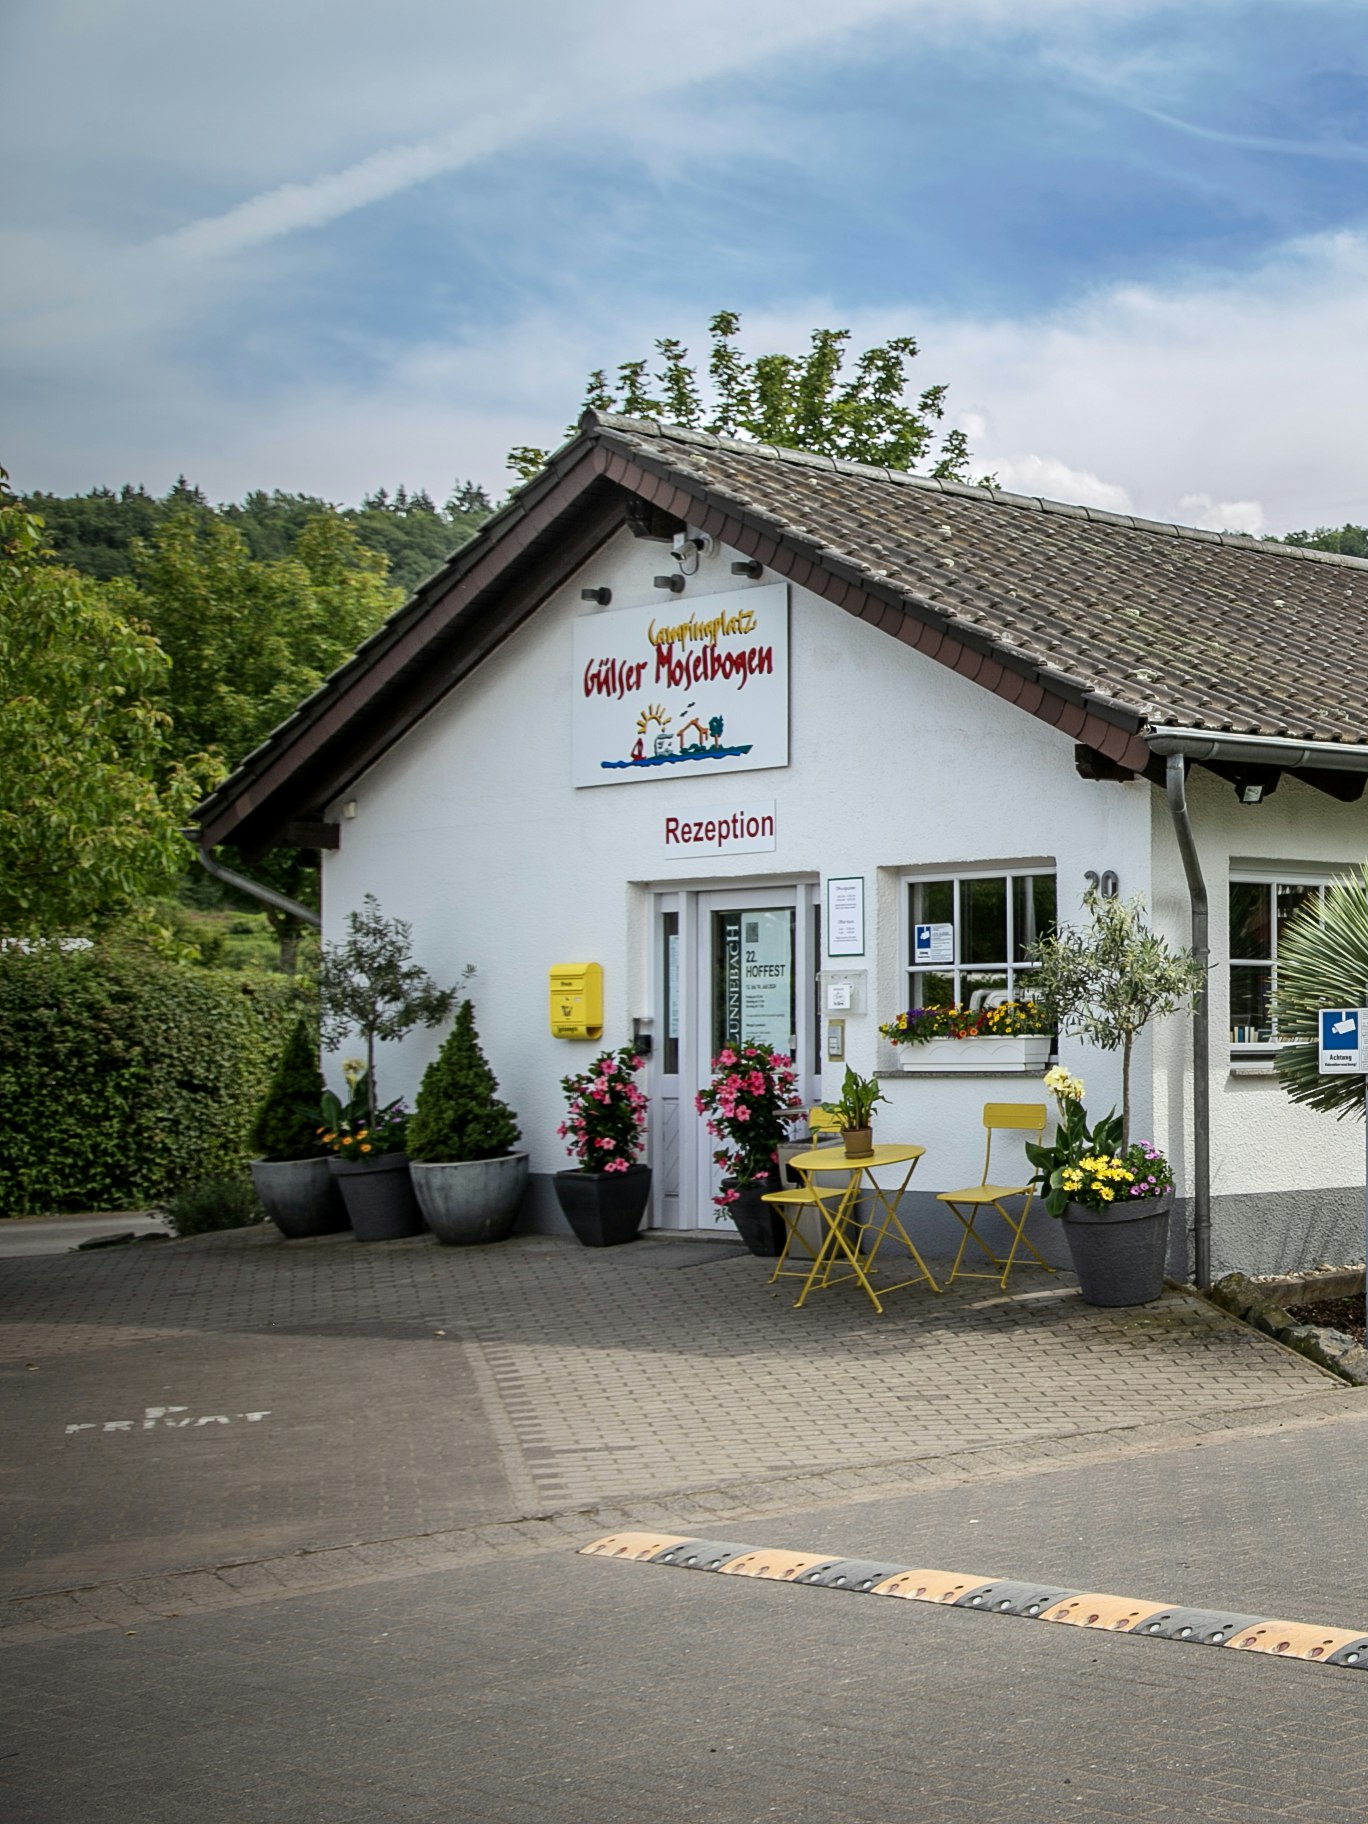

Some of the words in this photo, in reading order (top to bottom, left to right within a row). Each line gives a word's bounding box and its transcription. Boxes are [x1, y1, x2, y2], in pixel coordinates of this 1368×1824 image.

[647, 609, 757, 651] Campingplatz
[584, 657, 648, 699] Gülser
[654, 643, 773, 691] Moselbogen
[665, 811, 774, 847] Rezeption
[745, 950, 758, 963] 22.
[745, 964, 786, 978] HOFFEST
[1329, 1053, 1353, 1062] Achtung
